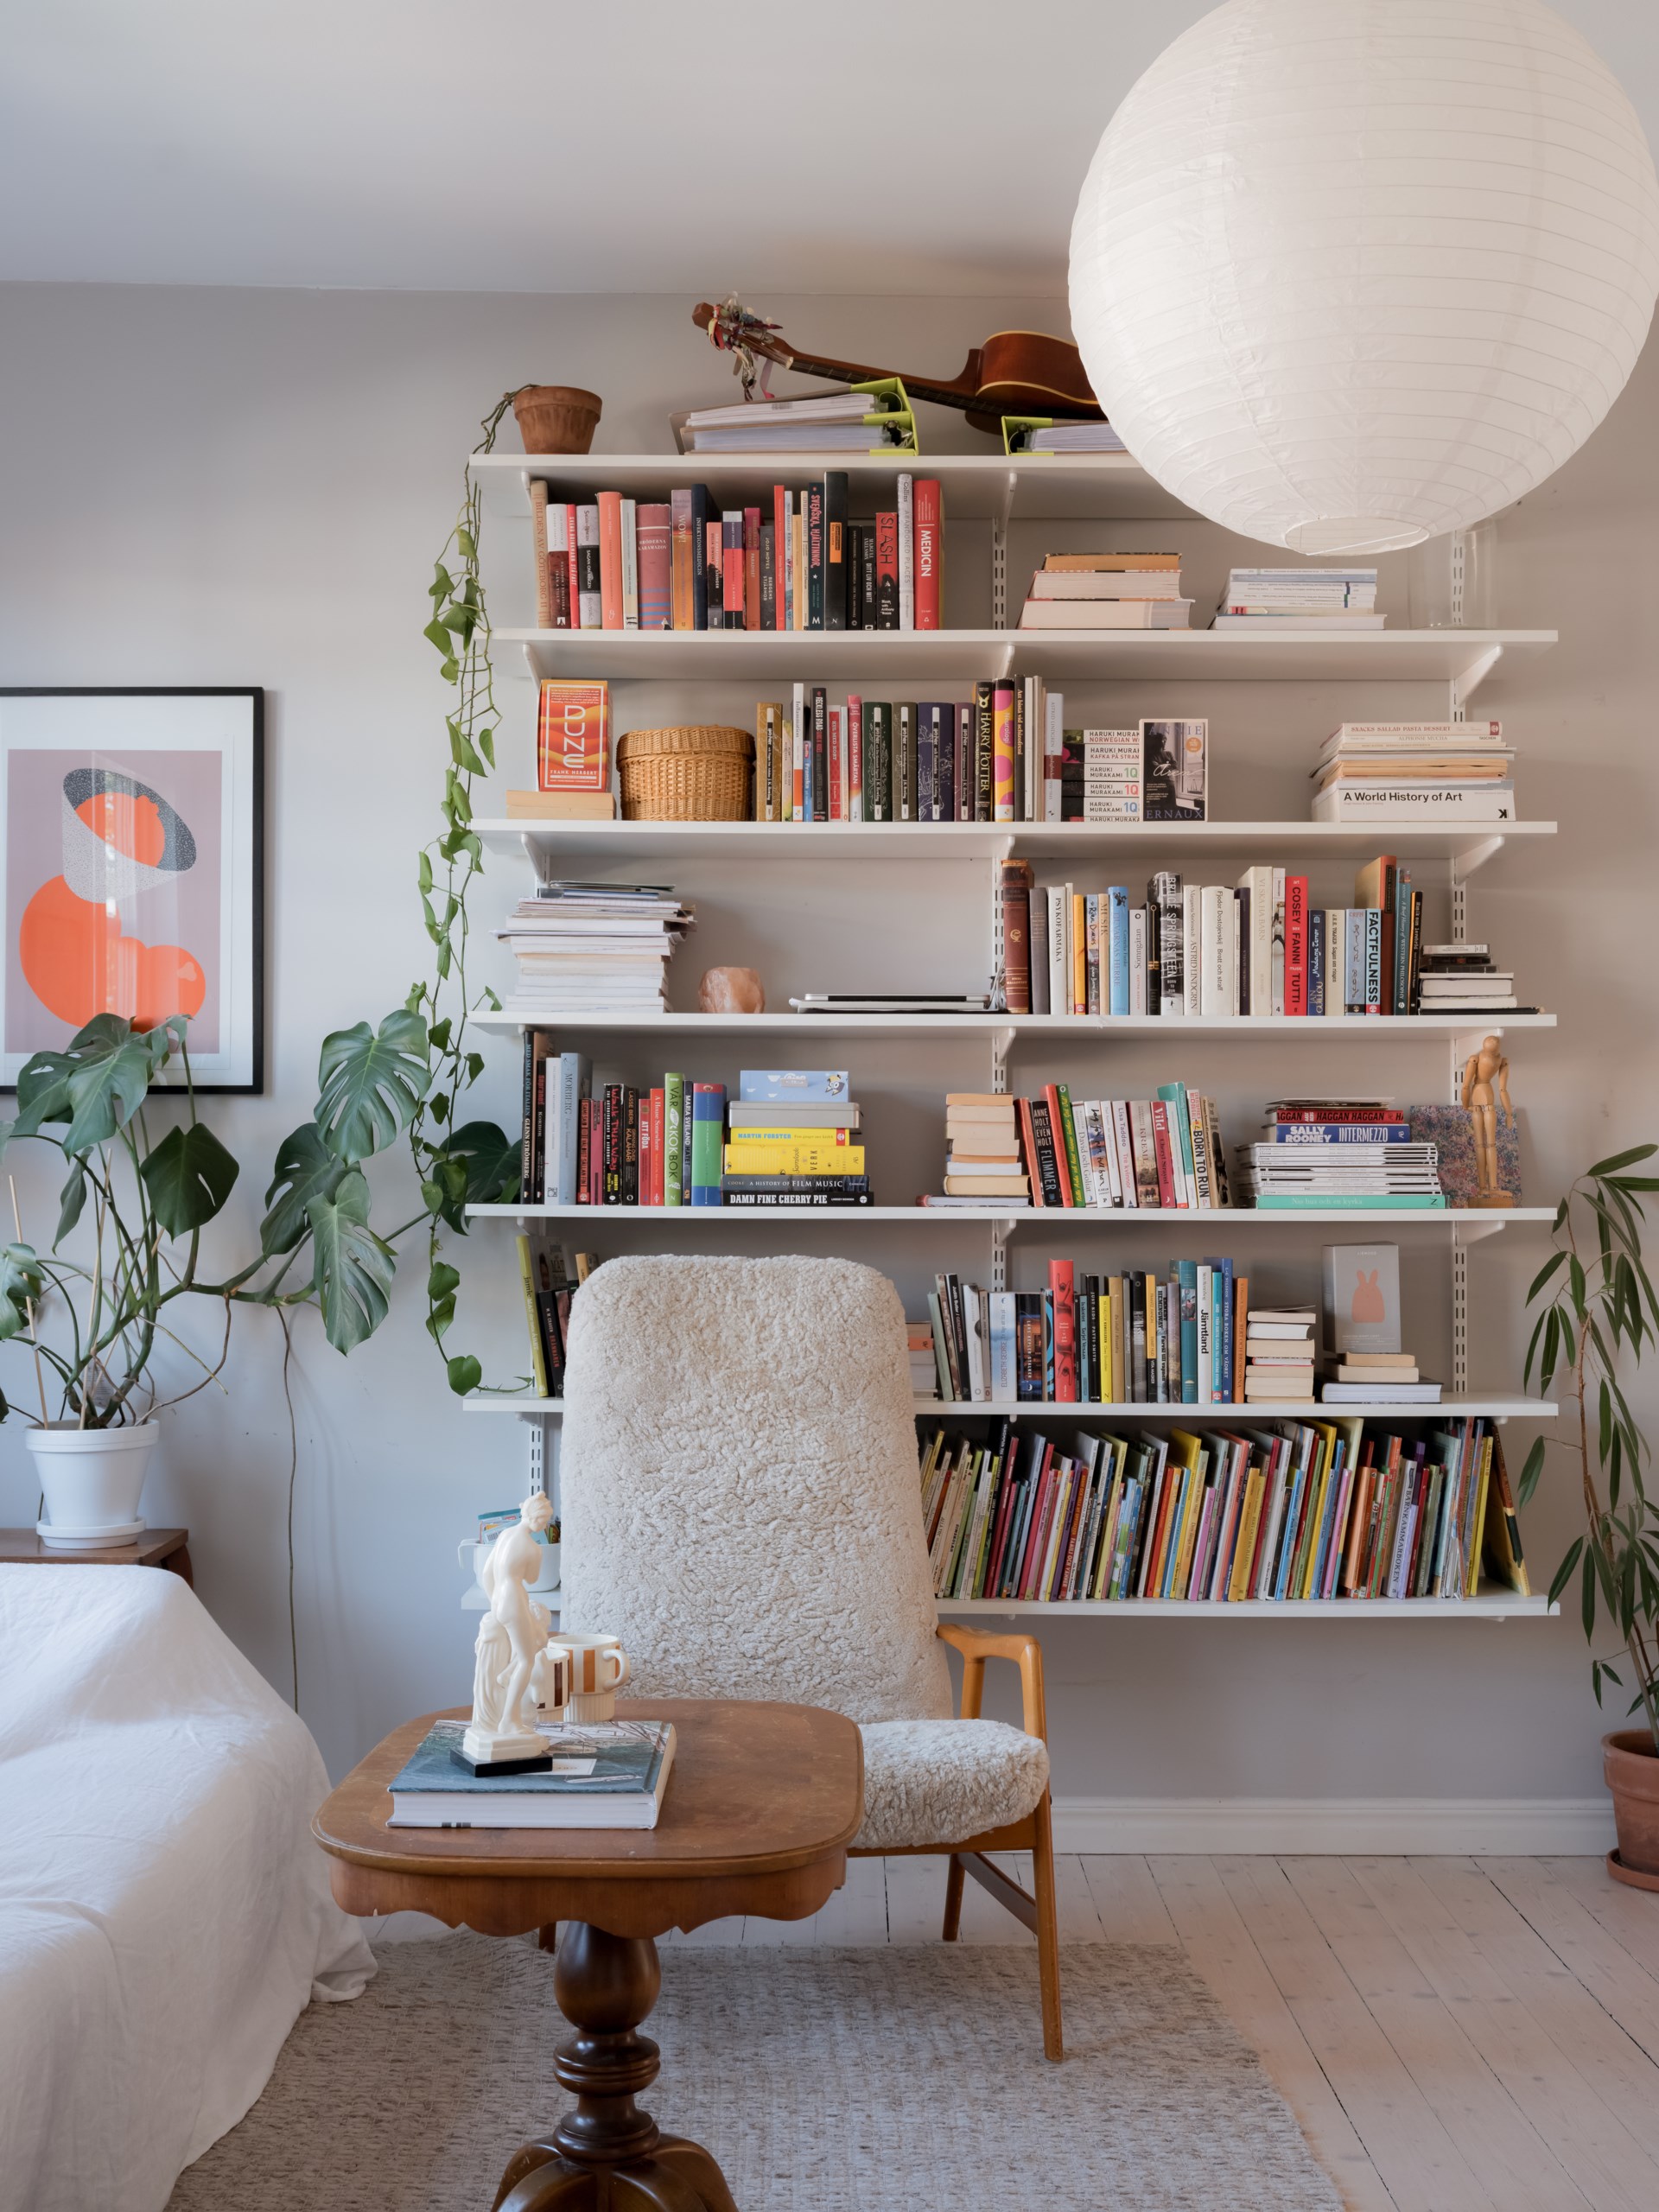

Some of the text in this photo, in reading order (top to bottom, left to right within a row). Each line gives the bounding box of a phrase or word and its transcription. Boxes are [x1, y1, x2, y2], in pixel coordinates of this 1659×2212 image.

[536, 502, 546, 535] BILDEN
[810, 495, 822, 527] SVENSKA
[537, 537, 547, 549] AV
[677, 514, 686, 543] WOW!
[880, 517, 893, 563] SLASH
[810, 529, 822, 568] HJÄLTINNOR
[920, 531, 931, 576] MEDICIN
[538, 553, 549, 599] GÖTEBORG
[563, 705, 586, 768] DUNE
[980, 712, 991, 791] HARRY POTTER
[1124, 767, 1138, 778] 1Q
[1124, 785, 1138, 795] 1Q
[1344, 792, 1462, 803] A World History of Art
[1123, 802, 1140, 812] 1Q
[1147, 810, 1203, 818] ERNAUX
[1259, 906, 1265, 917] HA
[1167, 877, 1177, 977] BRUCE SPRINGSTEEN
[1311, 948, 1321, 977] Madame
[1369, 912, 1378, 1002] FACTFULNESS
[564, 1073, 573, 1115] MORBERG
[1034, 1109, 1048, 1117] ANNE
[1154, 1108, 1165, 1130] Vild
[641, 1134, 650, 1149] FÖDA
[669, 1087, 682, 1178] VÅR KOKBOK
[1036, 1128, 1051, 1137] EVEN
[1290, 1126, 1326, 1135] SALLY
[1338, 1127, 1389, 1142] INTERMEZZO
[1140, 1128, 1148, 1164] KREML
[1040, 1150, 1056, 1190] FLIMMER
[1193, 1131, 1210, 1198] BORN TO RUN
[730, 1195, 755, 1204] DAMN
[757, 1195, 777, 1204] FINE
[779, 1195, 810, 1204] CHERRY
[813, 1195, 828, 1204] PIE
[1224, 1345, 1229, 1355] OM
[1067, 1538, 1077, 1554] FAMILJ
[1393, 1490, 1412, 1583] BARNKAMMARBOKEN
[1062, 1567, 1071, 1587] VÄNNER
